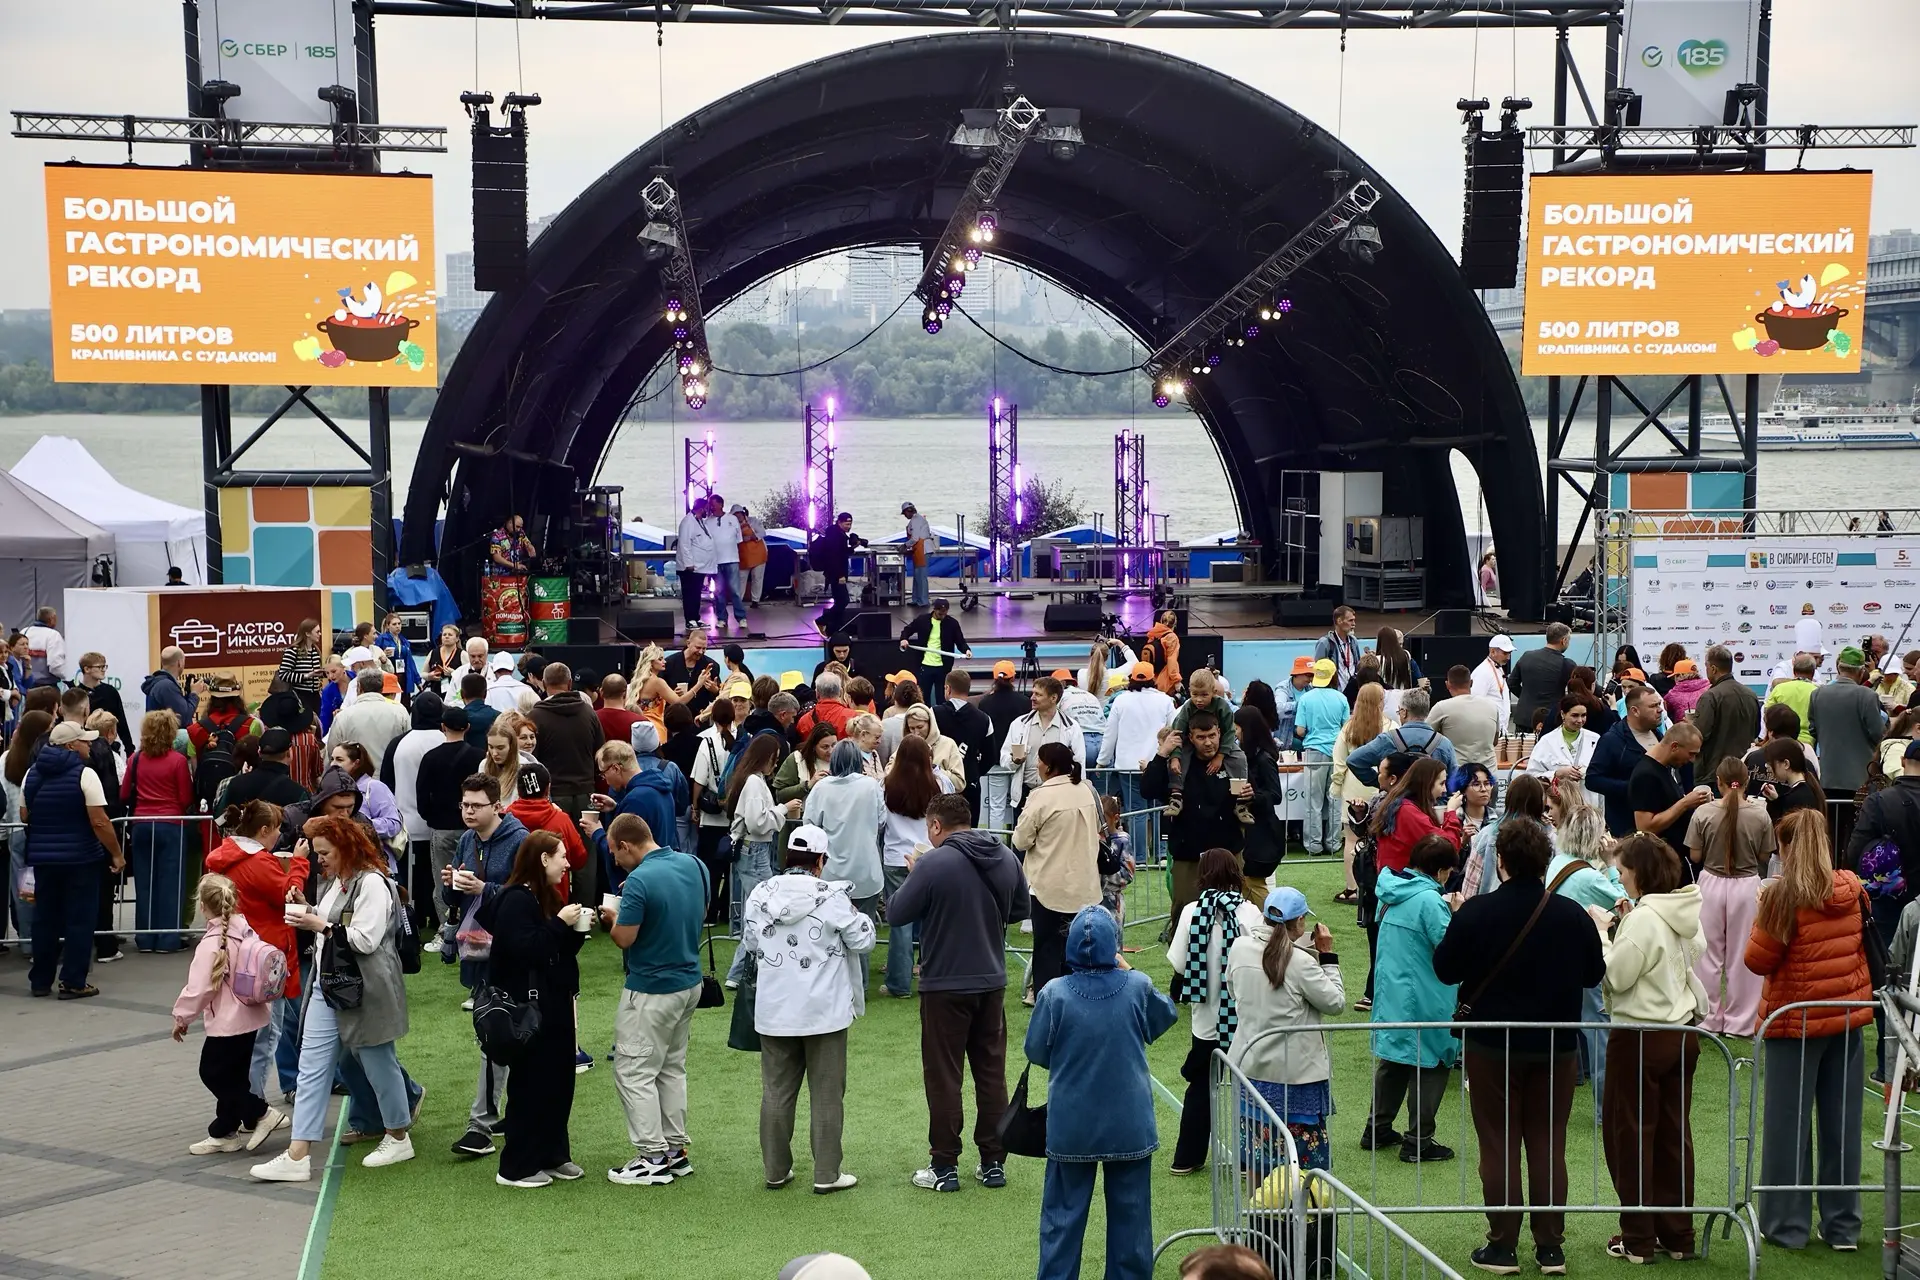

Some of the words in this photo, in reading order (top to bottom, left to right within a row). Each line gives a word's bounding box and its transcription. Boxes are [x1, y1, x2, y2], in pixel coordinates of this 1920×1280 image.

[243, 43, 287, 56] СБЕР
[304, 46, 336, 58] 185
[1681, 47, 1724, 66] 185
[64, 196, 236, 224] БОЛЬШОЙ
[1544, 198, 1693, 225] БОЛЬШОЙ
[66, 231, 418, 261] ГАСТРОНОМИЧЕСКИЙ
[1543, 228, 1854, 256] ГАСТРОНОМИЧЕСКИЙ
[67, 265, 201, 293] РЕКОРД
[1541, 266, 1656, 289] РЕКОРД
[70, 324, 118, 343] 500
[125, 325, 234, 345] ЛИТРОВ
[1539, 321, 1580, 338] 500
[1585, 321, 1680, 338] ЛИТРОВ
[71, 349, 179, 362] КРАПИВНИКА
[182, 350, 193, 361] С
[195, 350, 277, 363] СУДАКОМ!
[1538, 344, 1631, 355] КРАПИВНИКА
[1633, 344, 1643, 354] С
[1645, 343, 1717, 355] СУДАКОМ!
[1769, 553, 1775, 565] В
[1777, 552, 1834, 565] СИБИРИ-ЕСТЬ!
[228, 622, 284, 635] ГАСТРО
